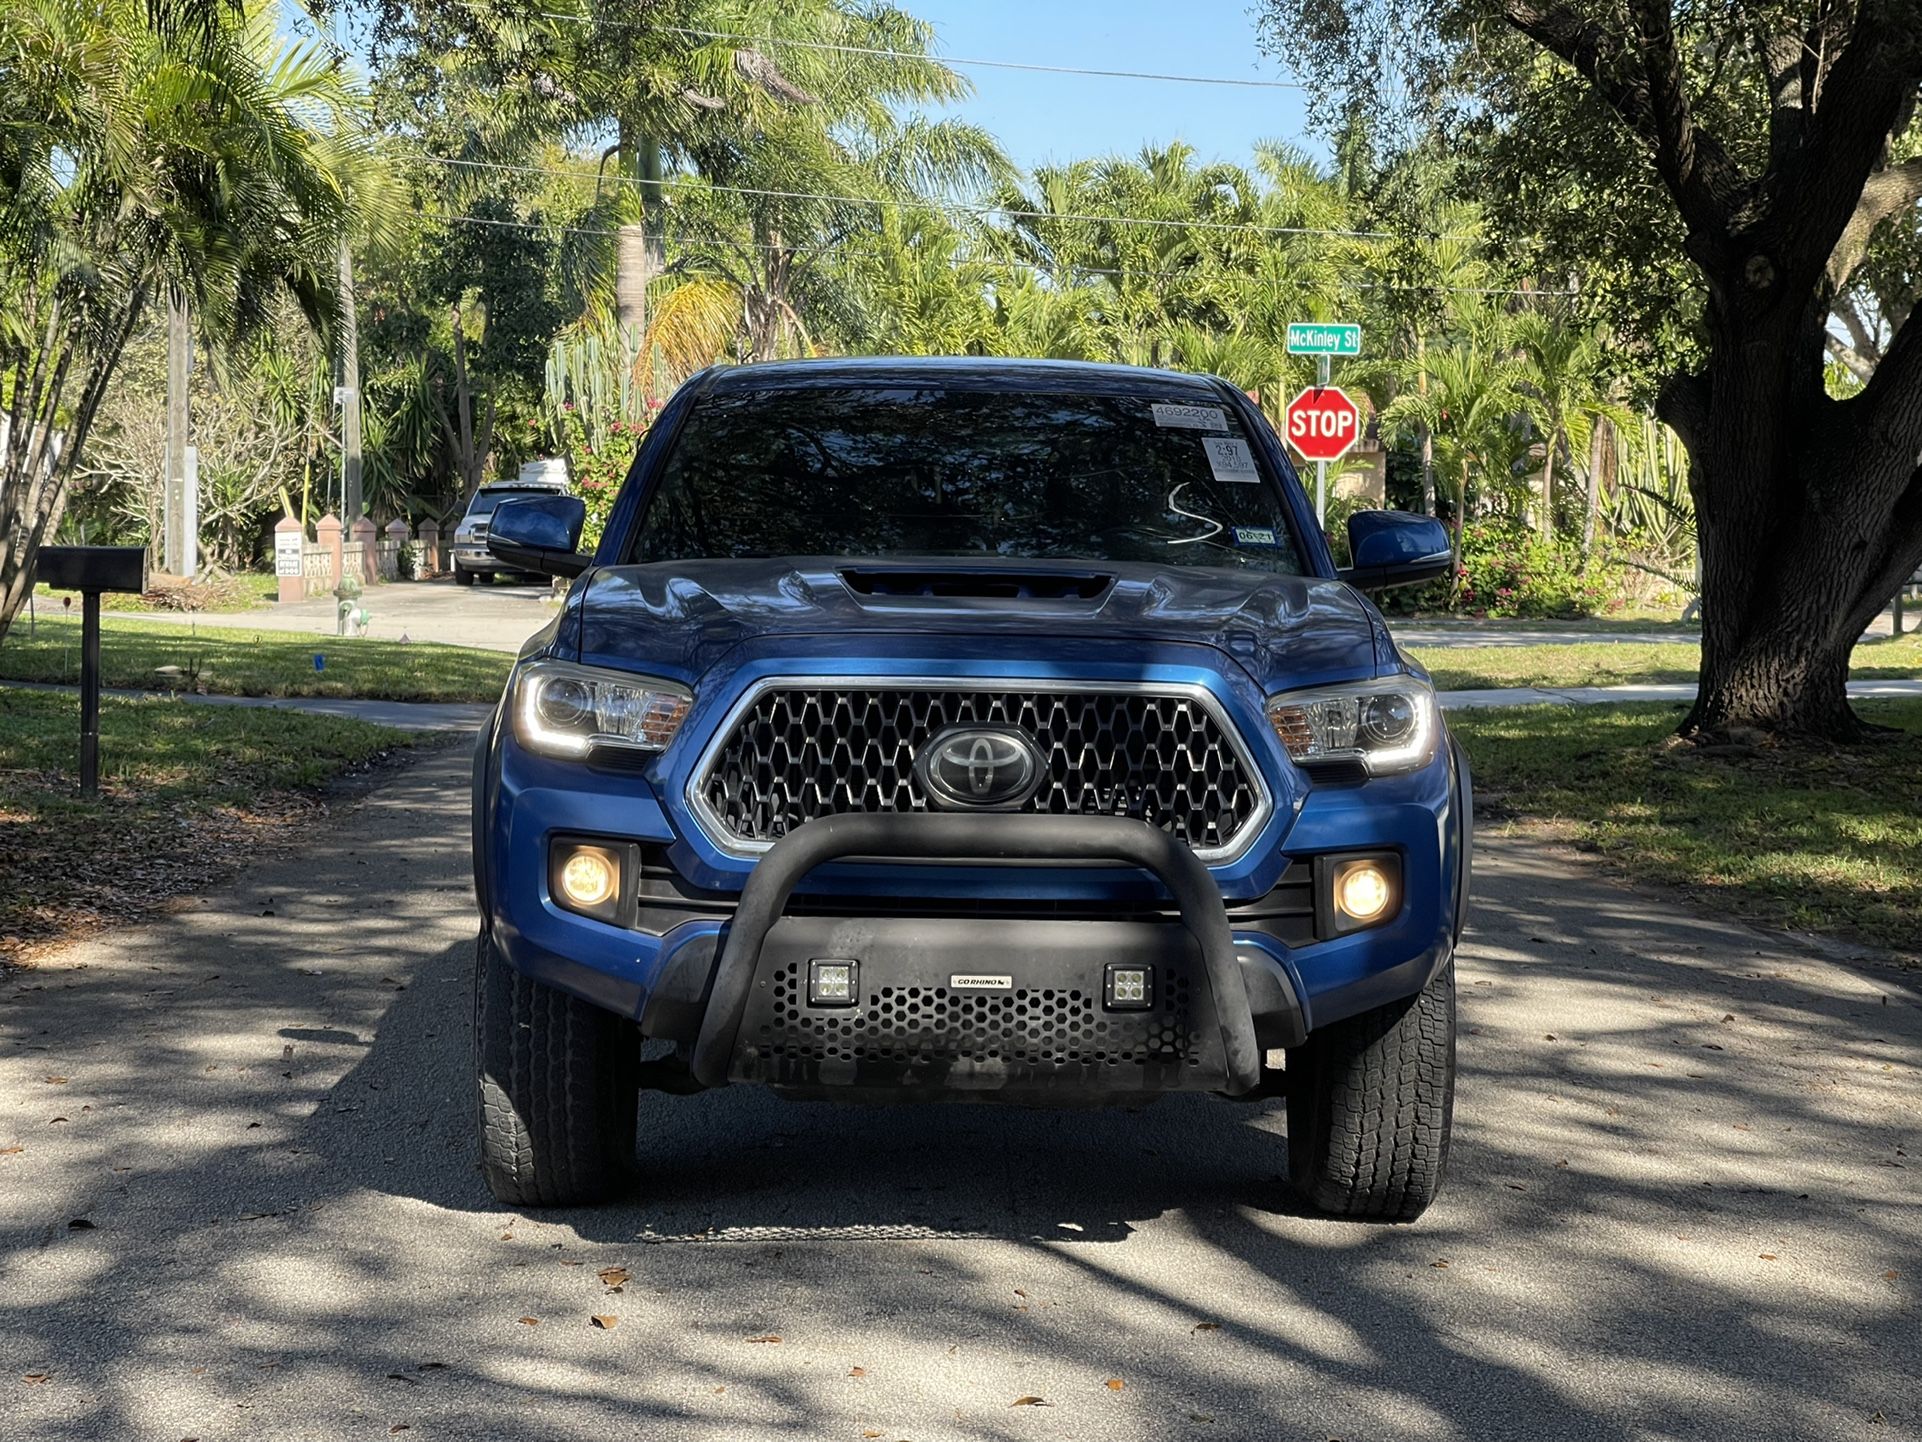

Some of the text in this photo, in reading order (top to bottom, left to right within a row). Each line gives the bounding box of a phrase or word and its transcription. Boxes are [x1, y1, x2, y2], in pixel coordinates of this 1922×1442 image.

[1290, 330, 1357, 351] McKinley St
[1156, 406, 1218, 420] 4692200
[1291, 409, 1353, 437] STOP
